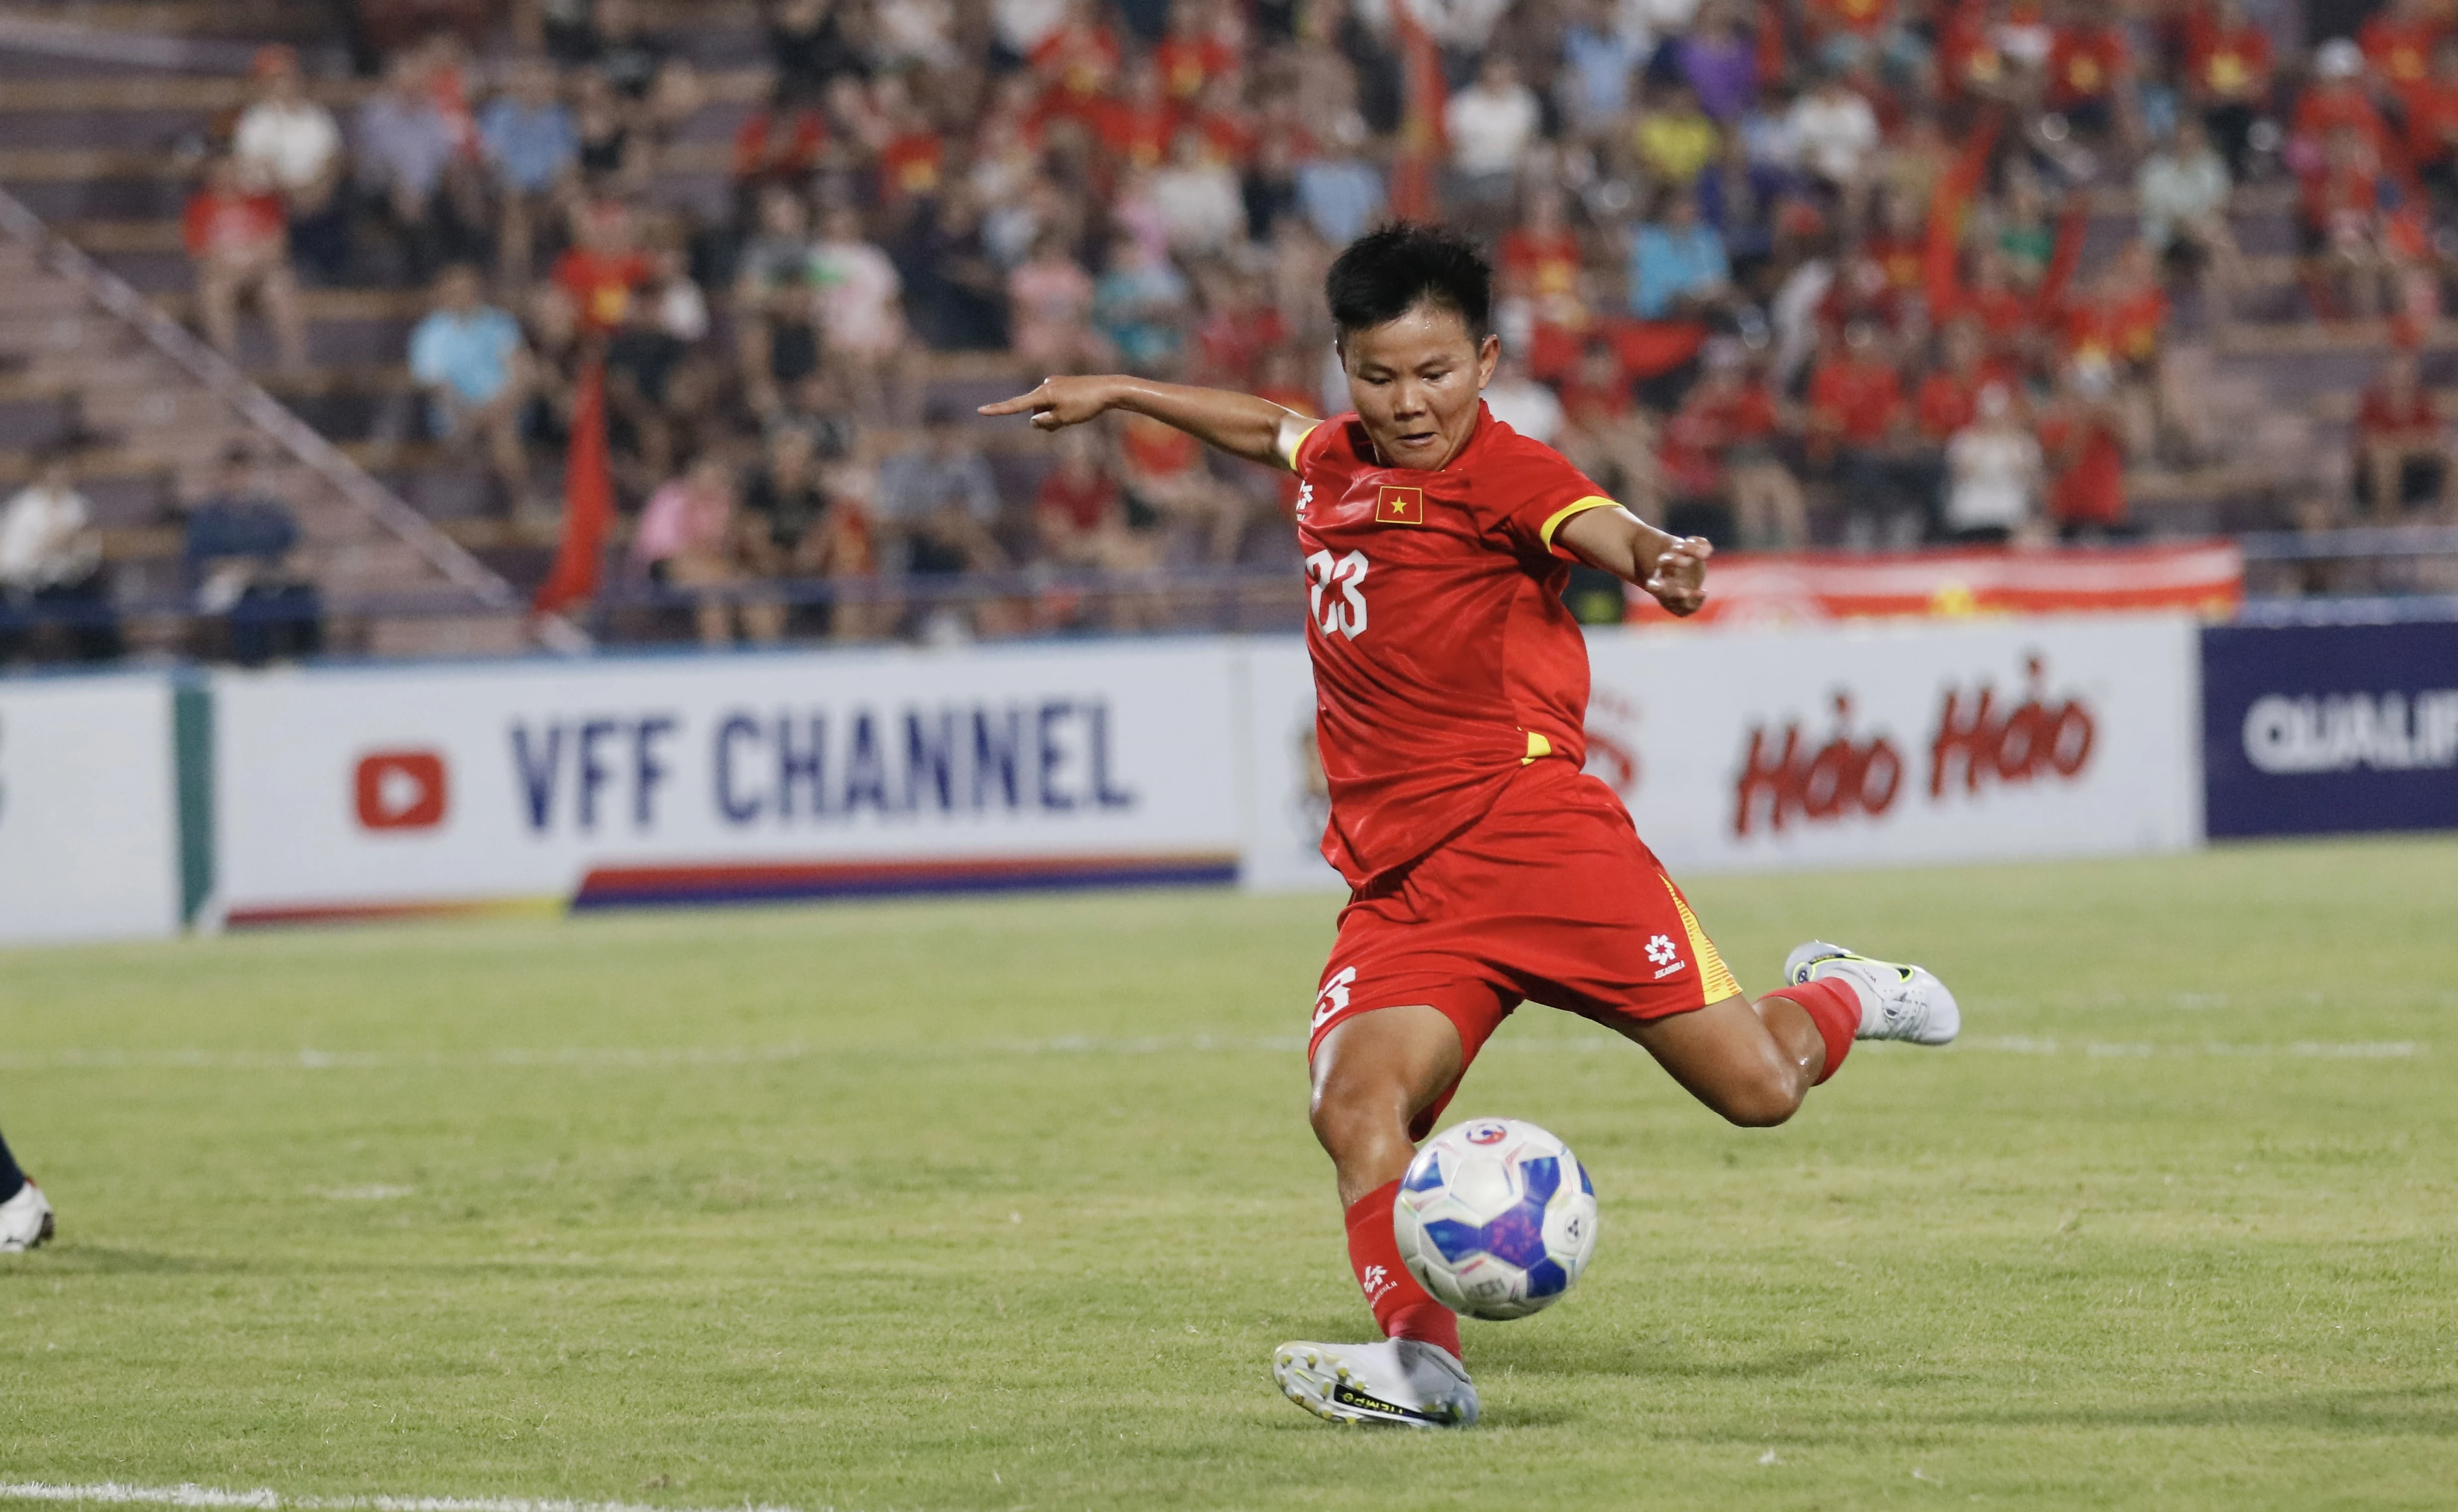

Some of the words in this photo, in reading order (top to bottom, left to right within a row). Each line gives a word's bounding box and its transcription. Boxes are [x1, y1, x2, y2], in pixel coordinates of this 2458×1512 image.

[1305, 549, 1369, 642] 23
[510, 716, 679, 830] VFF
[716, 703, 1137, 823] CHANNEL
